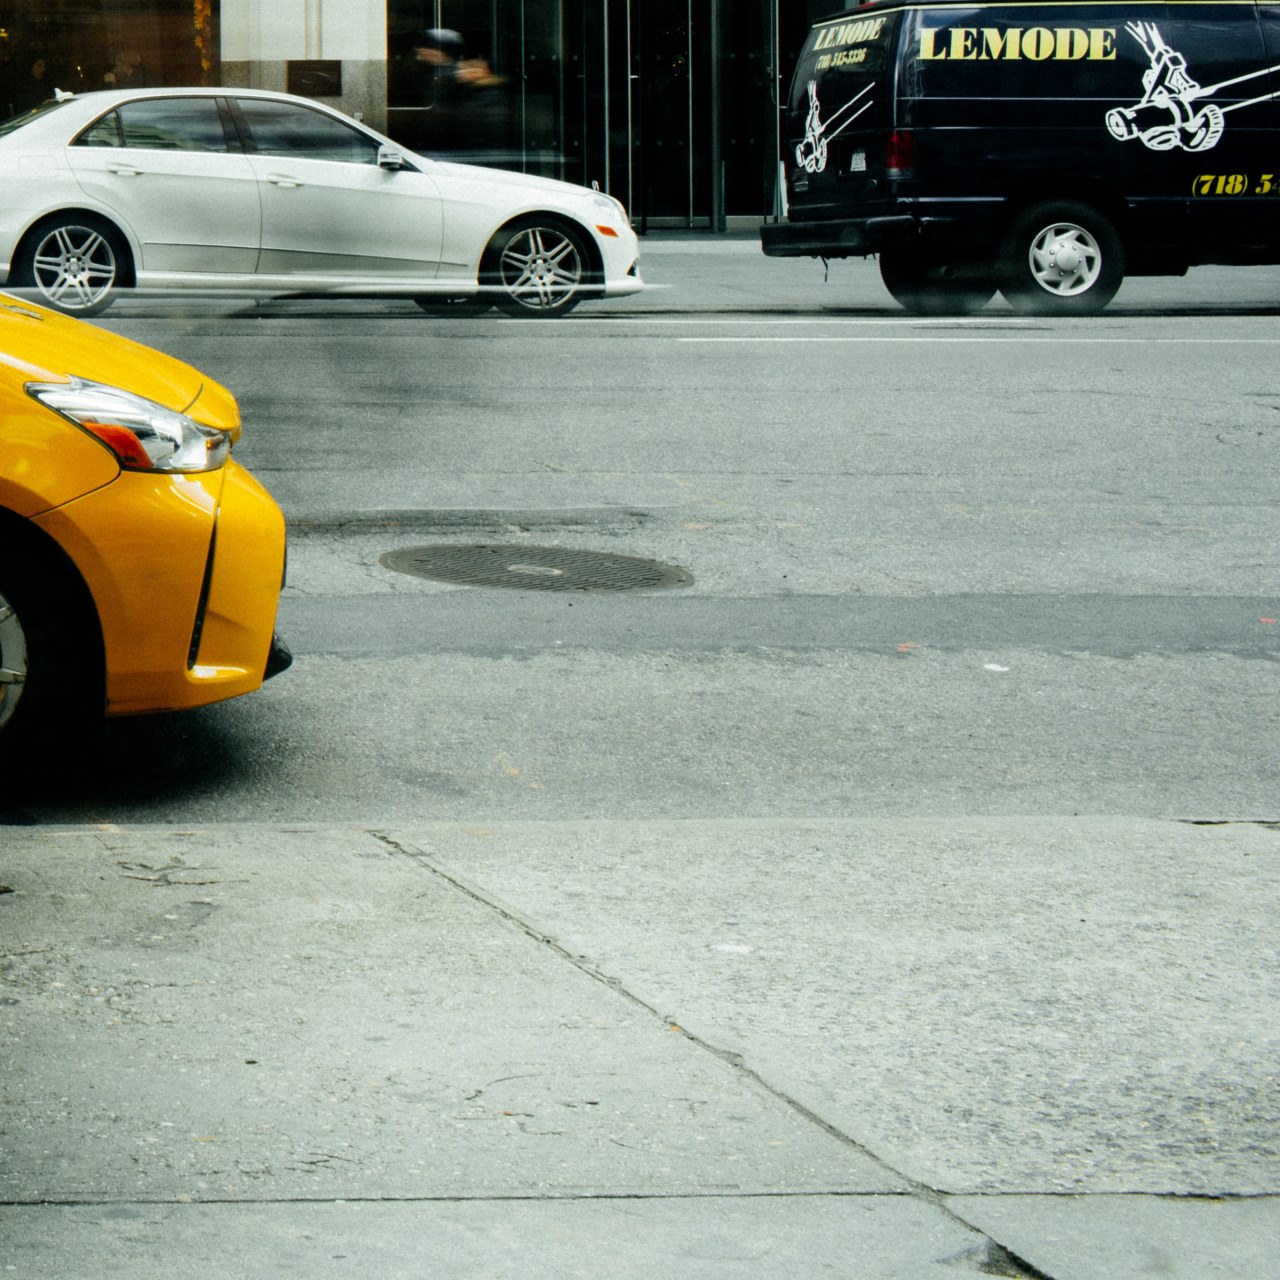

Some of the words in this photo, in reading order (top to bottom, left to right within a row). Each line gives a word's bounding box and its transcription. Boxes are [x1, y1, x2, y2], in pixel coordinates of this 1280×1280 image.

[812, 17, 887, 51] LEMODE
[916, 26, 1117, 61] LEMODE
[1192, 174, 1248, 199] (718)
